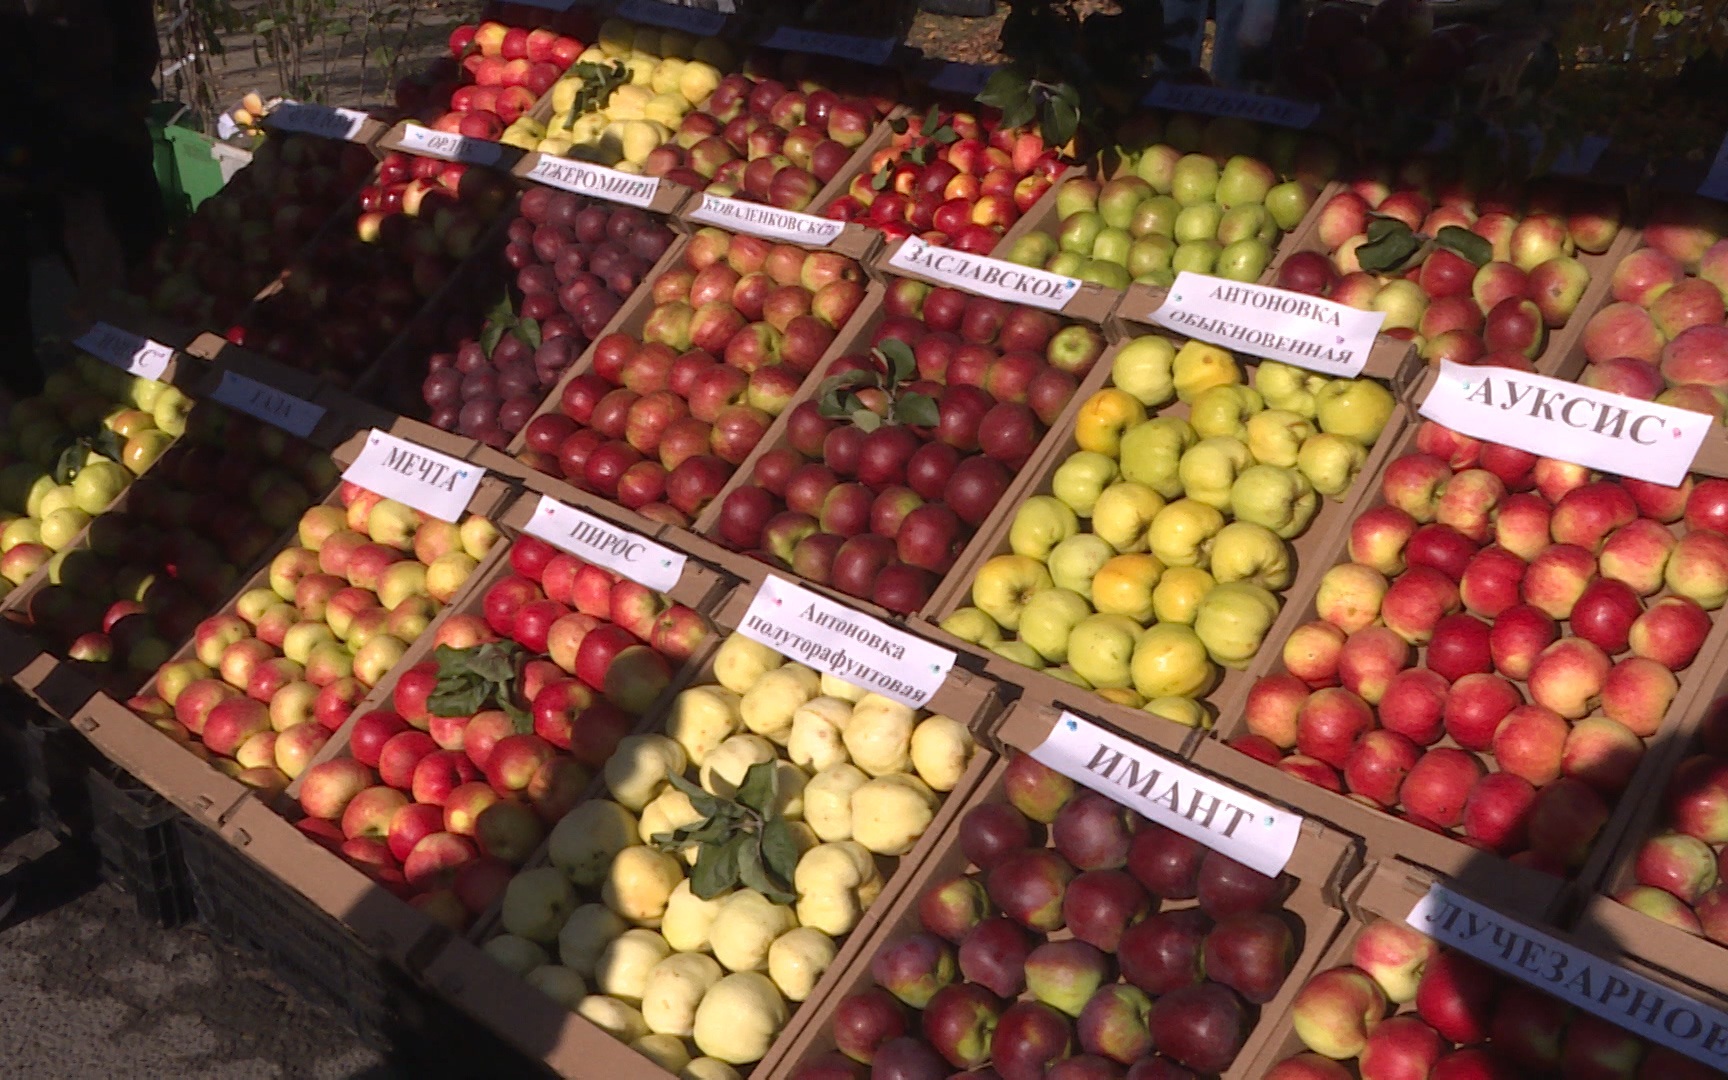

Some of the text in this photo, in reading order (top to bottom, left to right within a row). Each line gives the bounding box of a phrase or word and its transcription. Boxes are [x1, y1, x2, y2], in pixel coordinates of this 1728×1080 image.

[533, 161, 655, 198] ДЖЕРОМИНИ
[904, 243, 1064, 300] ЗАСЛАВСКОЕ
[1209, 285, 1341, 327] АНТОНОВКА
[1168, 310, 1353, 364] ОБЫКНОВЕННАЯ
[1465, 376, 1666, 446] АУКСИС
[381, 446, 463, 492] МЕЧТА
[569, 521, 647, 562] ПИРОС
[746, 615, 928, 702] полуторафунтовая
[799, 601, 906, 660] Антоновка
[1084, 742, 1254, 839] ИМАНТ
[1425, 899, 1728, 1058] ЛУЧЕЗАРНОЕ
